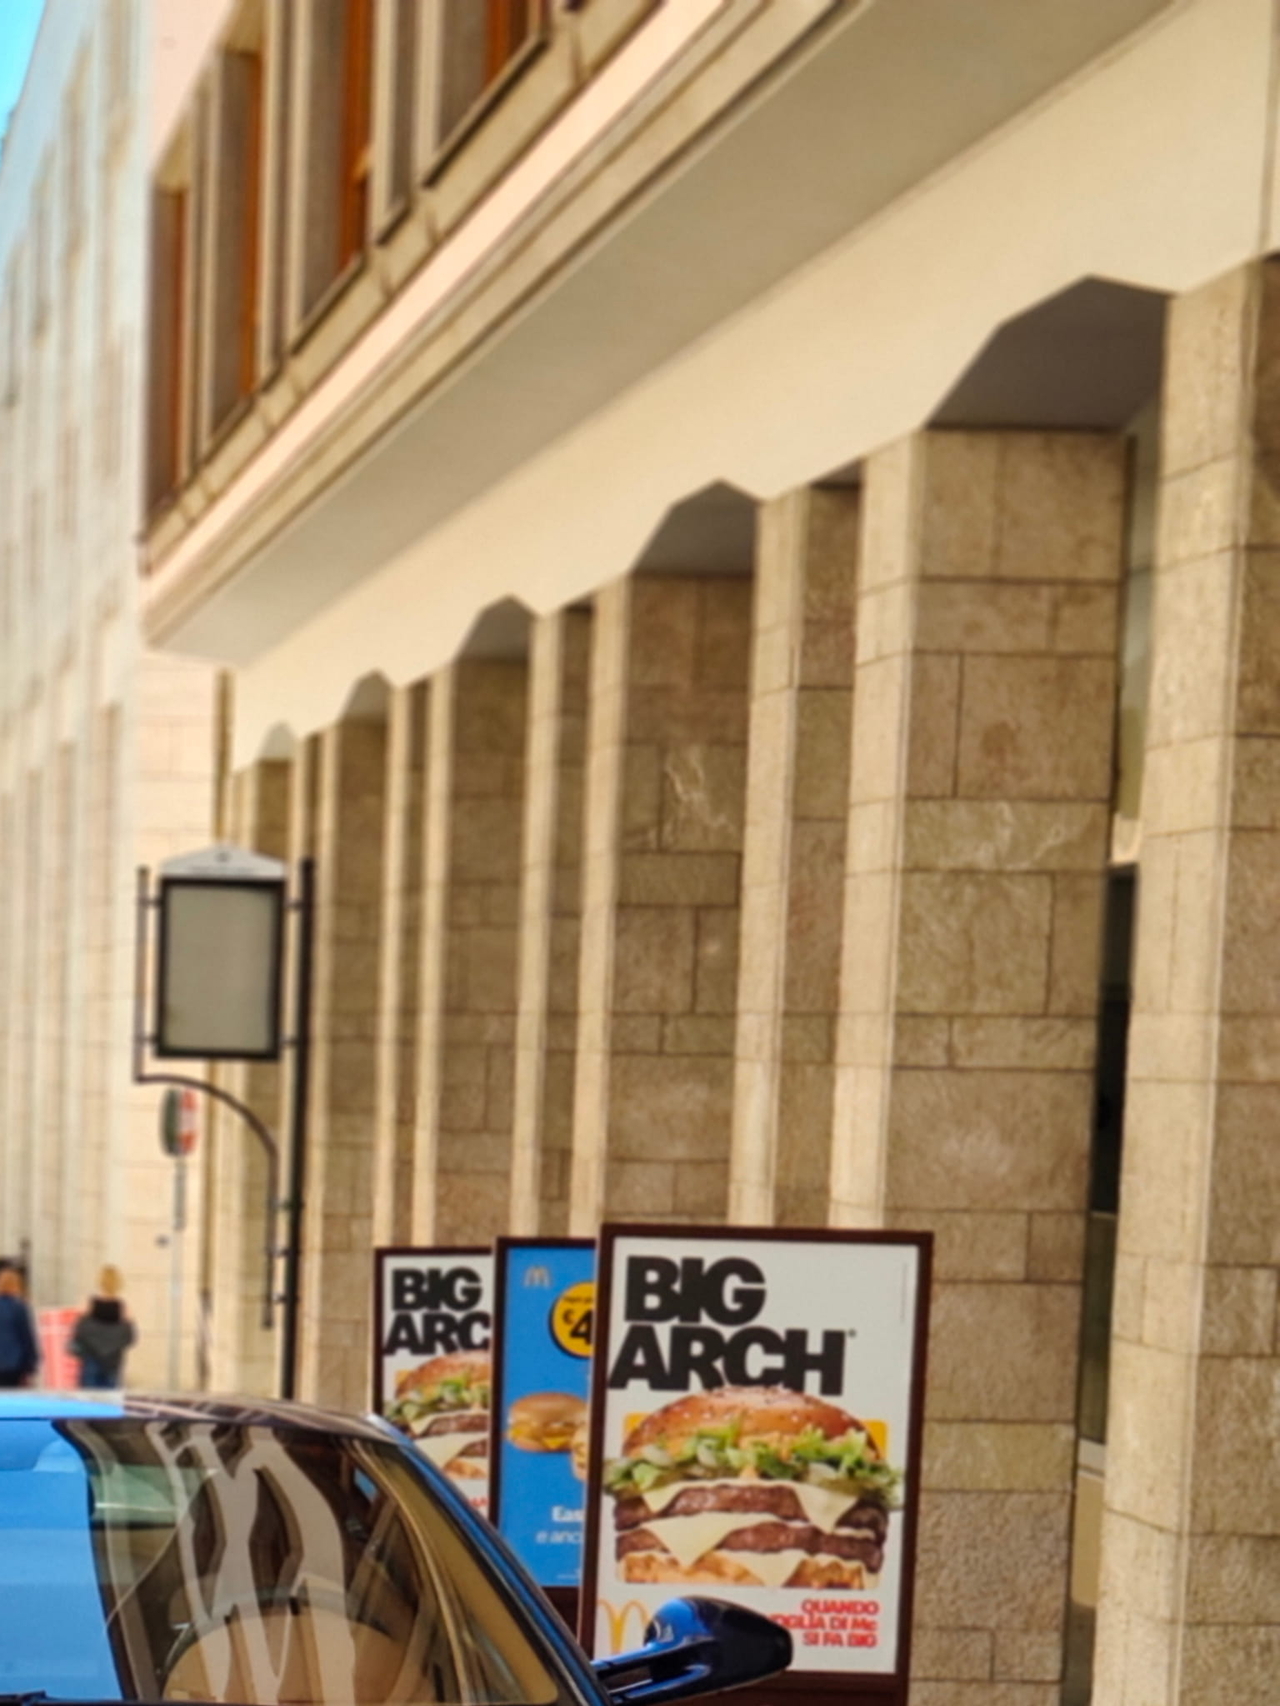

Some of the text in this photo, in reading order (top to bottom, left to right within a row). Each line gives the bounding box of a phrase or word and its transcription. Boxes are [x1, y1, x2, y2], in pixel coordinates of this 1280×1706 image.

[392, 1267, 483, 1312] BIG
[624, 1256, 766, 1326] BIG
[384, 1312, 491, 1356] ARC
[552, 1506, 585, 1523] Eas
[550, 1531, 583, 1545] anc
[801, 1598, 880, 1616] QUANDO
[770, 1614, 826, 1630] OGLIA
[830, 1616, 848, 1630] DI
